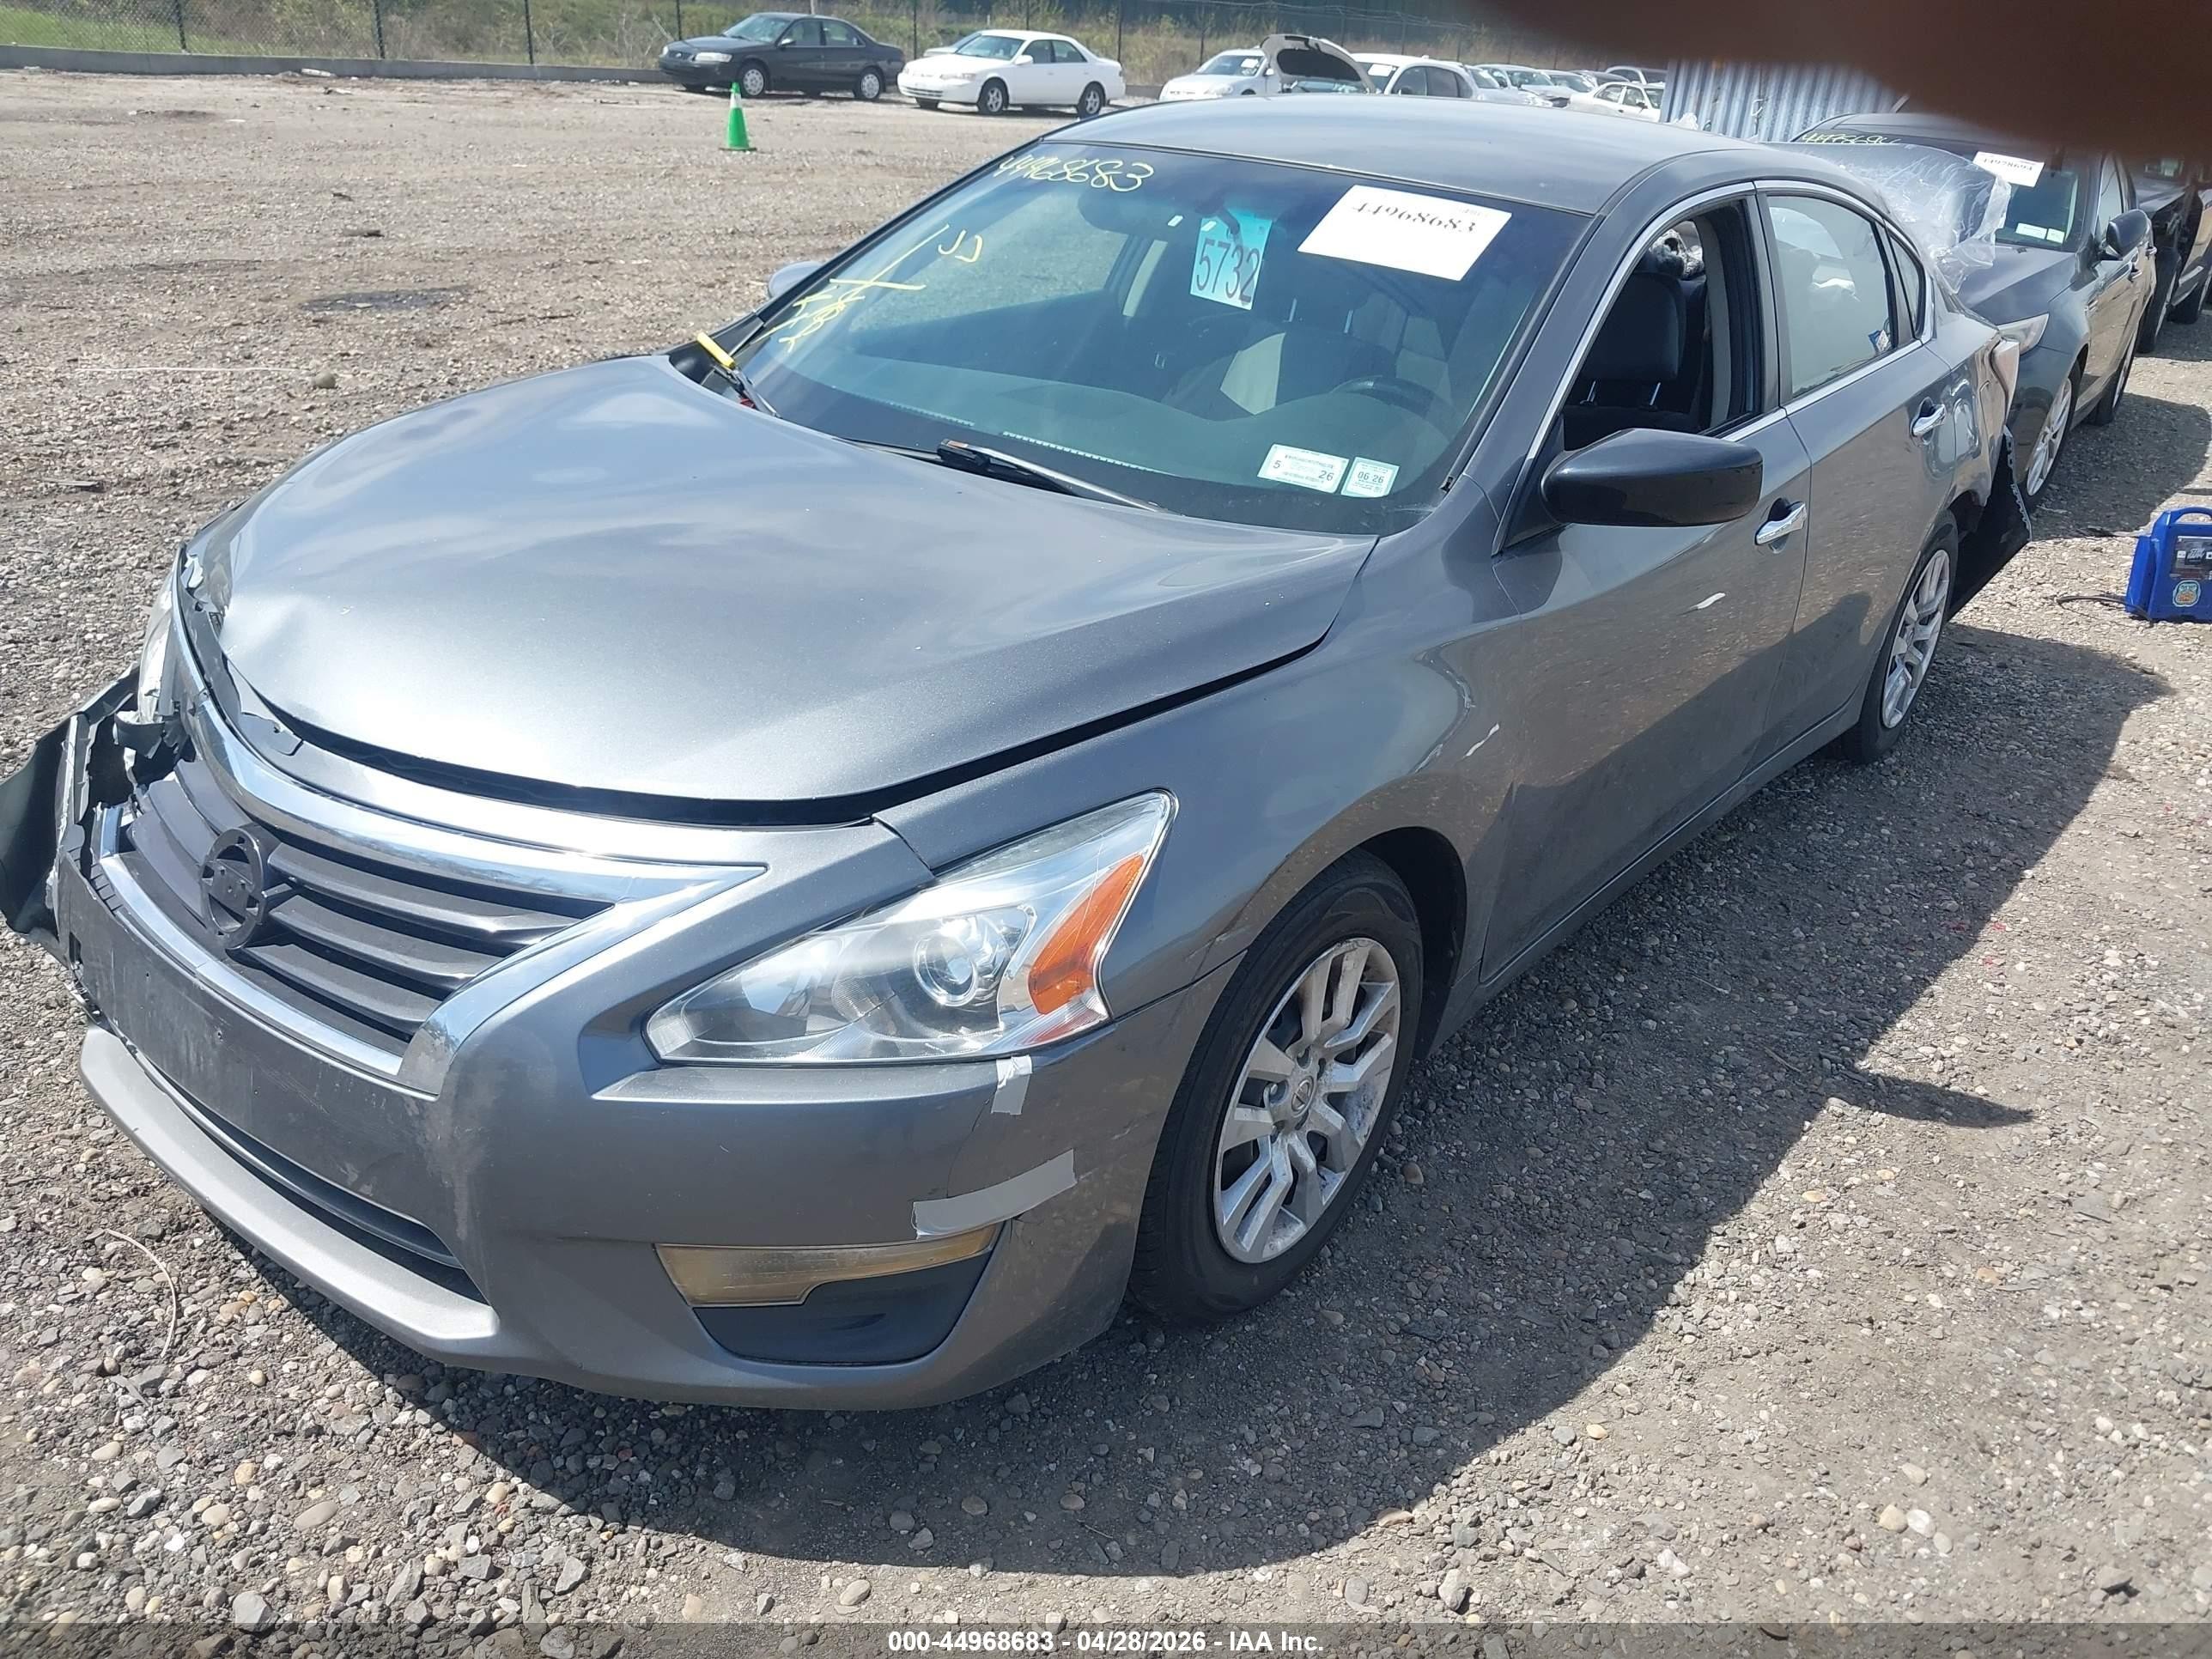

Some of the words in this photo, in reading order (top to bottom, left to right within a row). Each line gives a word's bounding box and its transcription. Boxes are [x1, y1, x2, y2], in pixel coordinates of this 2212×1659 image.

[1352, 202, 1477, 233] 44968683
[1196, 237, 1261, 304] 5732
[1273, 459, 1282, 470] 5
[1318, 470, 1334, 482] 26
[1372, 474, 1384, 483] 26
